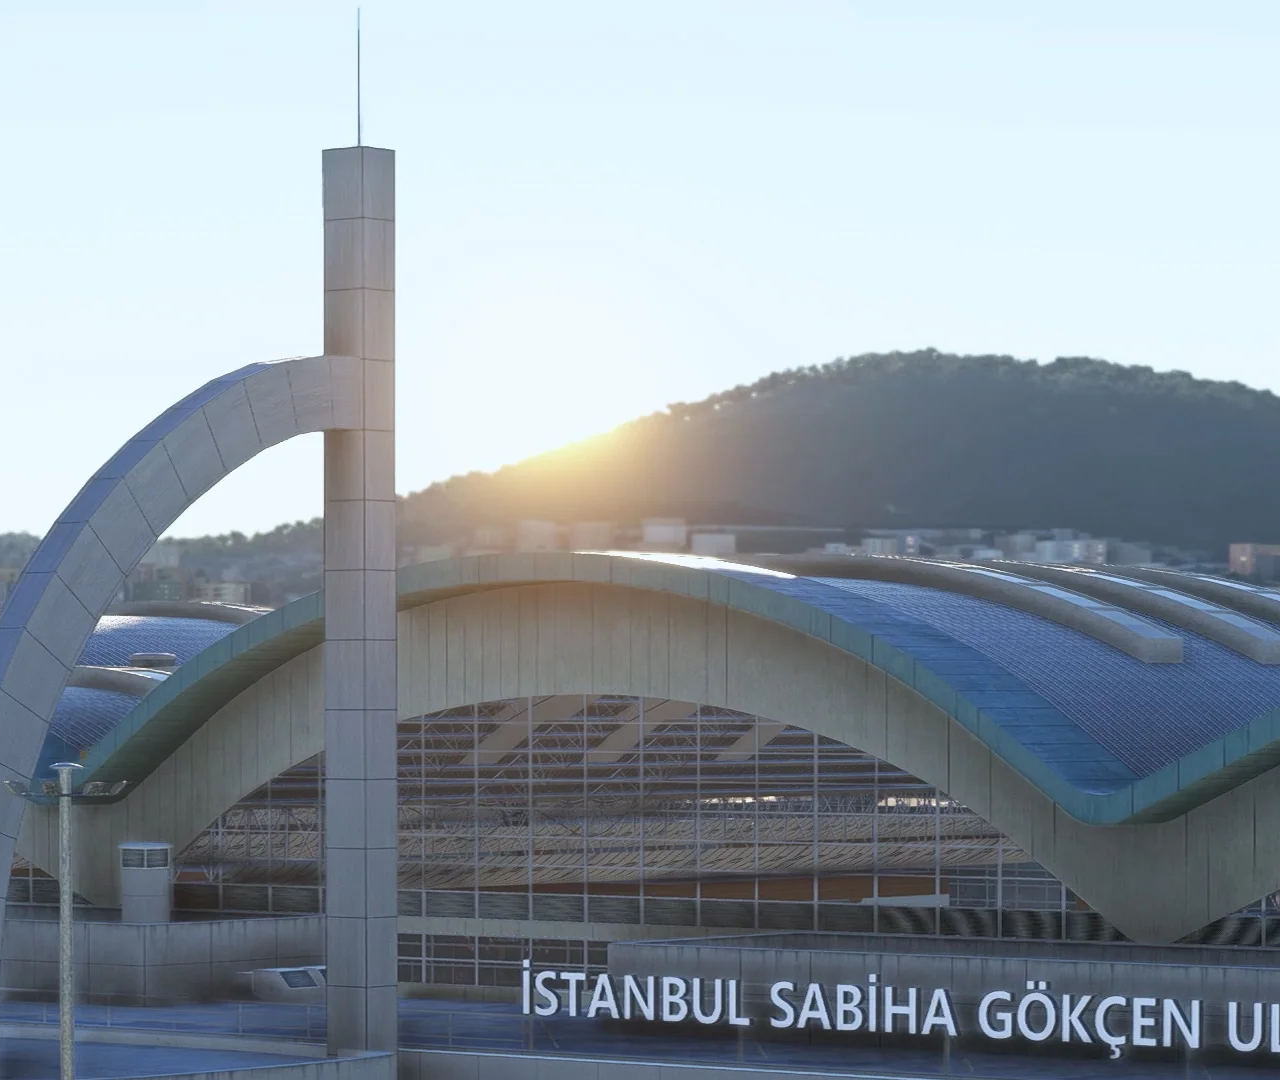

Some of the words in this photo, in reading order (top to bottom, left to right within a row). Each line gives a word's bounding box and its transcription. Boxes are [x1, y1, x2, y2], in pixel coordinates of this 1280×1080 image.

[521, 959, 753, 1028] İSTANBUL
[769, 973, 960, 1037] SABİHA
[977, 980, 1202, 1060] GÖKÇEN
